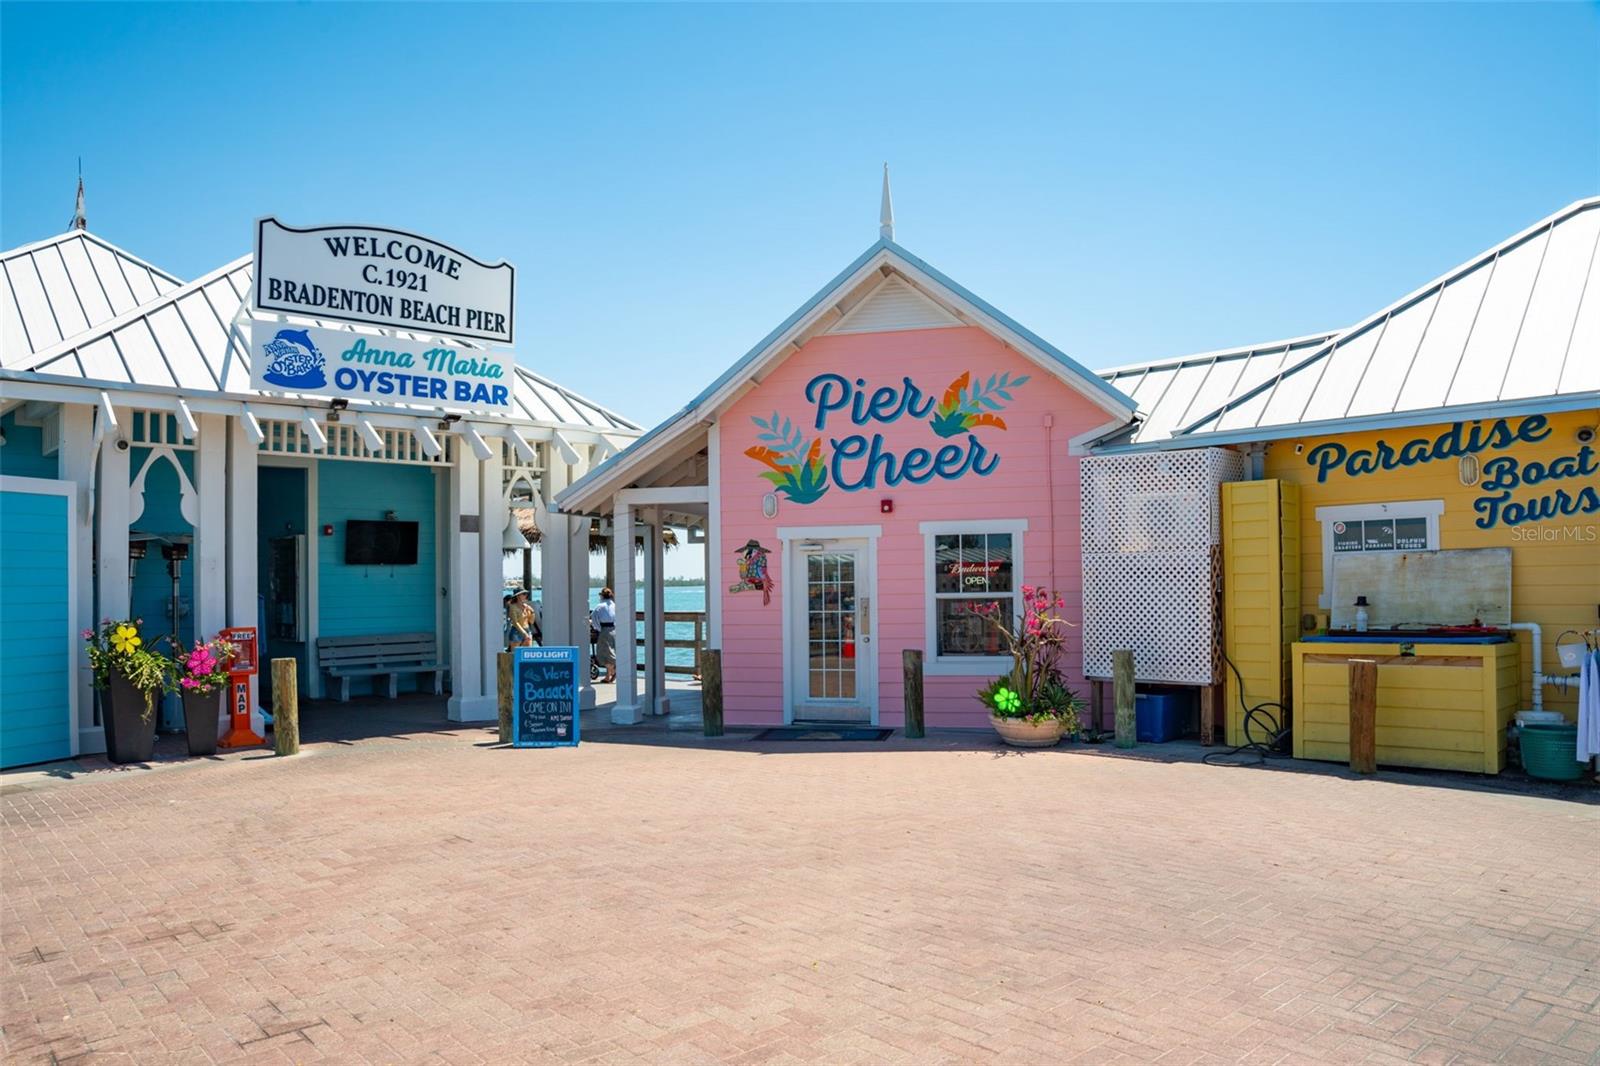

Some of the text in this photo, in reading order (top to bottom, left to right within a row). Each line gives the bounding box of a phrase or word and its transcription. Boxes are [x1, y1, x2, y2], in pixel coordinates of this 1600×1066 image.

[324, 236, 462, 280] WELCOME
[362, 264, 429, 292] C.1921
[268, 277, 506, 334] BRADENTON BEACH PIER
[271, 354, 312, 373] OYSTER
[287, 362, 311, 376] BAR
[341, 338, 504, 379] Anna Maria
[334, 368, 509, 406] OYSTER BAR
[805, 373, 937, 432] Pier
[830, 433, 1000, 493] Cheer
[1306, 414, 1553, 484] Paradise
[1480, 445, 1600, 491] Boat
[1473, 486, 1600, 530] Tours
[965, 576, 987, 585] OPEN
[523, 651, 569, 659] BUD LIGHT
[237, 684, 246, 713] MAP
[523, 701, 545, 714] COME
[546, 701, 558, 713] ON
